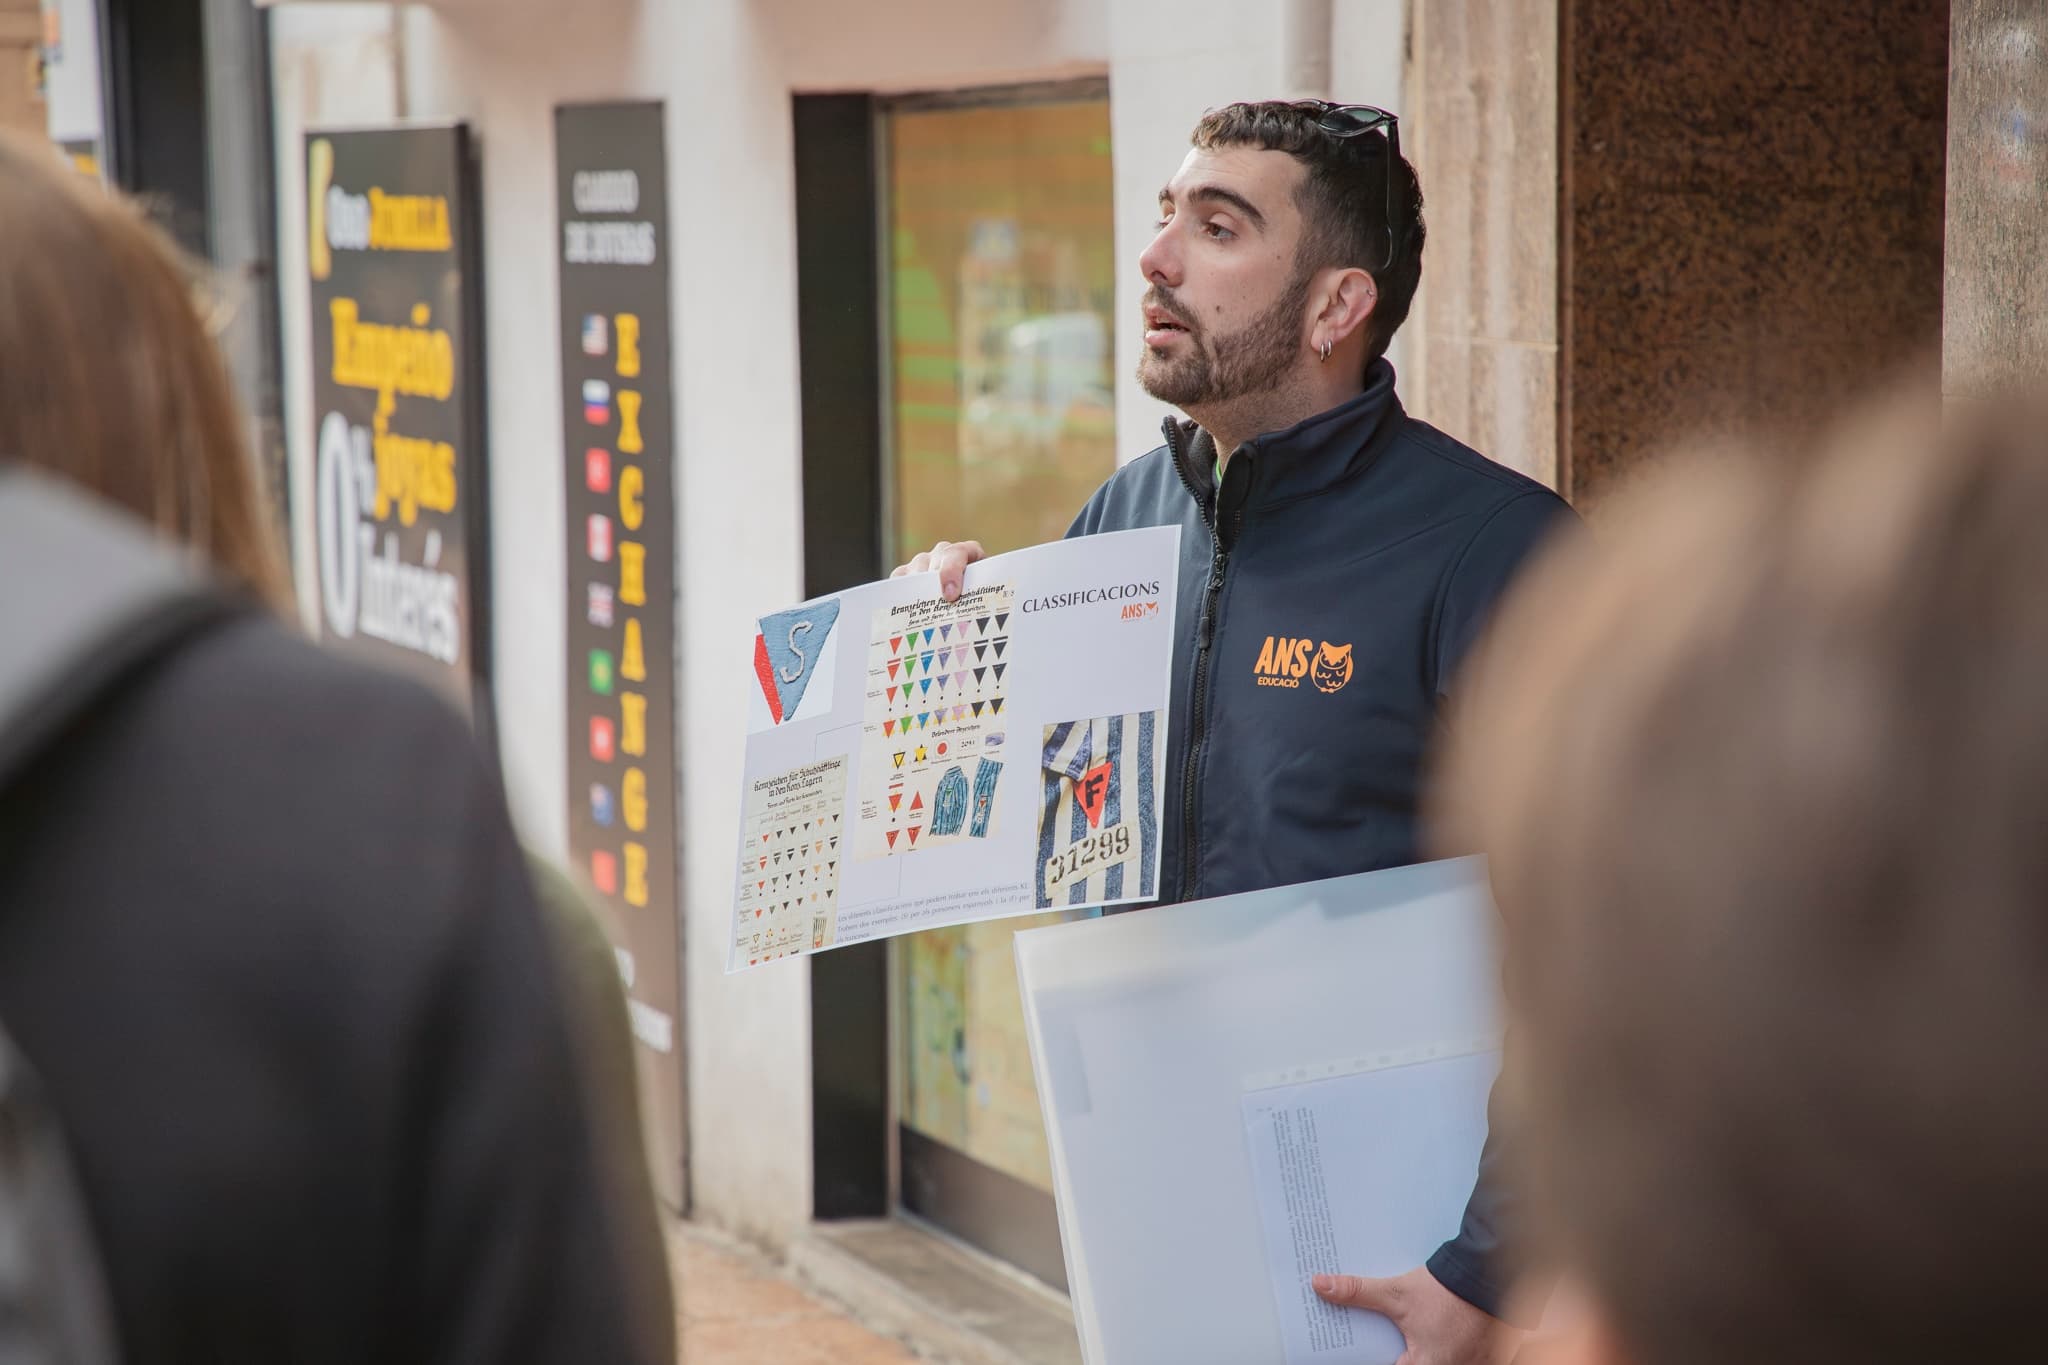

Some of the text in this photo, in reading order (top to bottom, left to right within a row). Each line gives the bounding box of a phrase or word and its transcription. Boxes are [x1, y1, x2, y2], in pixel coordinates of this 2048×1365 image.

[329, 297, 454, 416] Empeño
[373, 411, 457, 526] joyas
[614, 312, 649, 908] EXCHANGE
[1022, 580, 1160, 614] CLASSIFICACIONS
[1121, 603, 1143, 620] ANS
[778, 620, 814, 686] S
[1253, 636, 1313, 678] ANS
[1257, 676, 1300, 689] EDUCACIÓ
[1084, 773, 1104, 809] F
[1050, 826, 1130, 884] 31299
